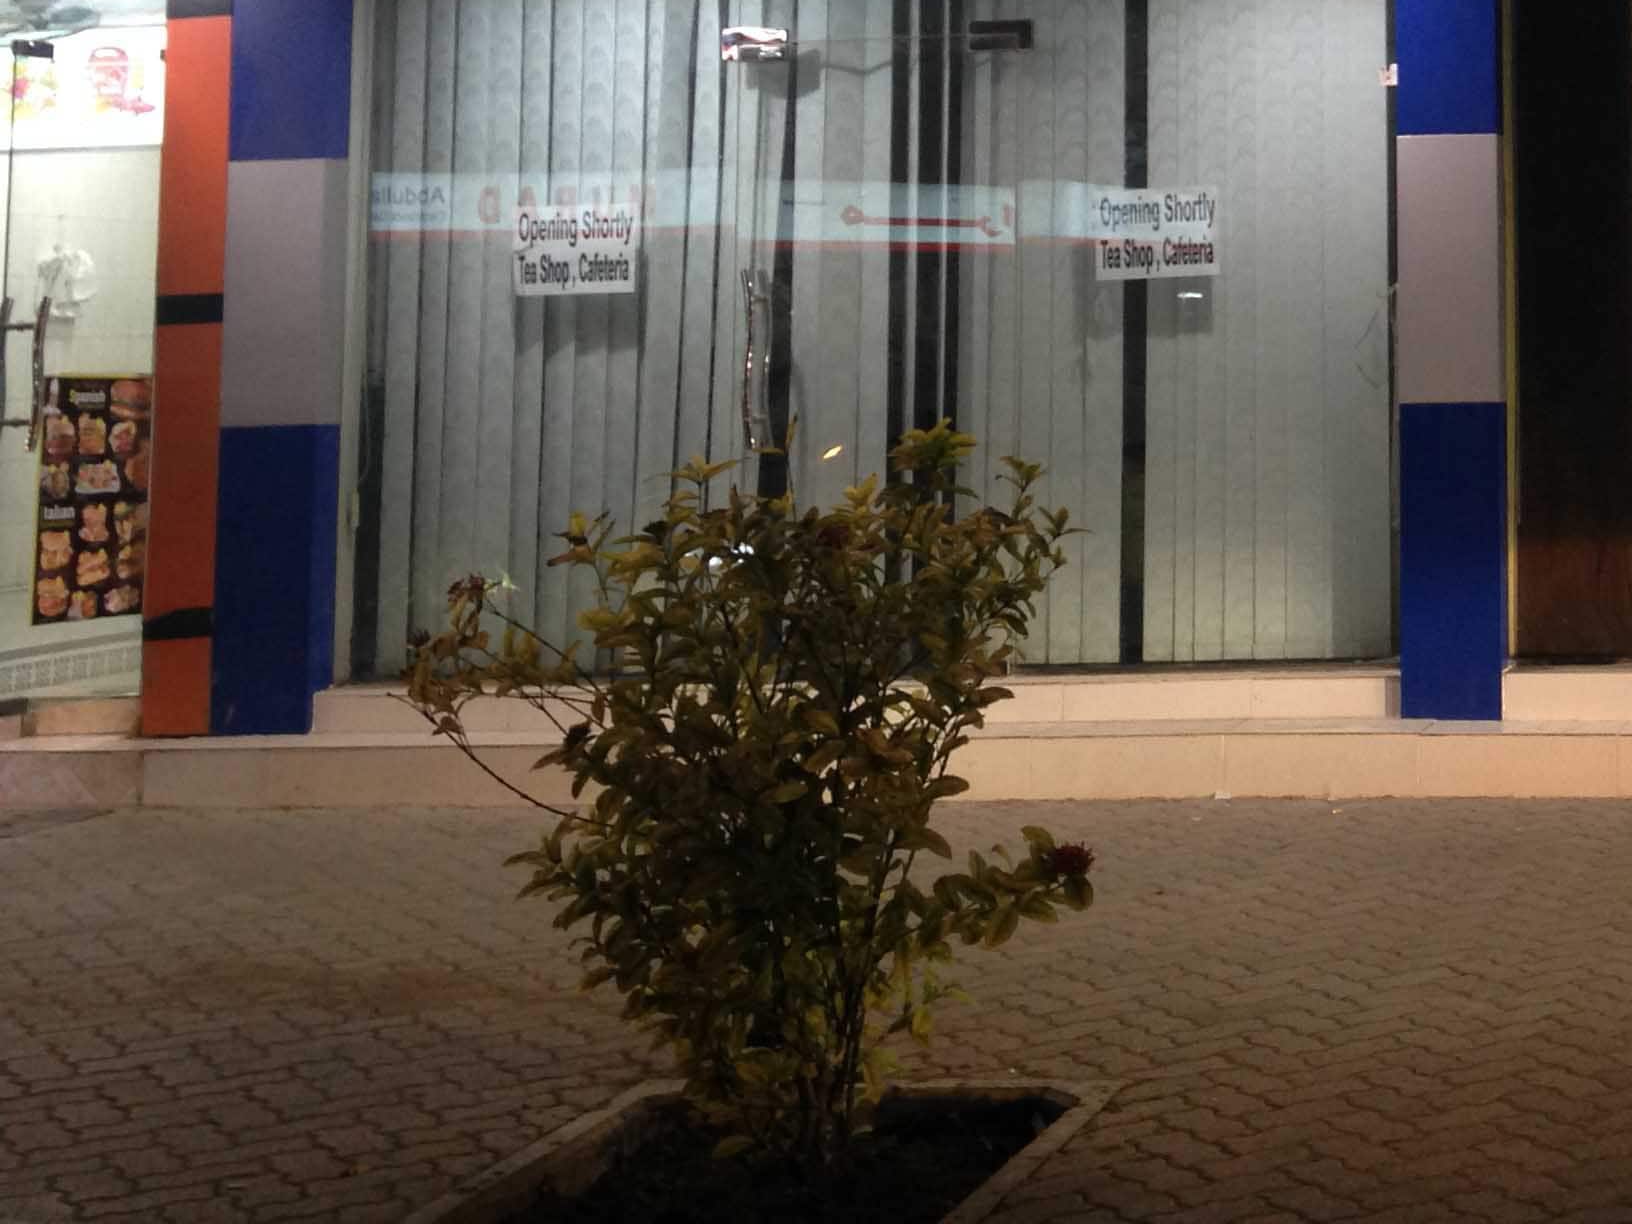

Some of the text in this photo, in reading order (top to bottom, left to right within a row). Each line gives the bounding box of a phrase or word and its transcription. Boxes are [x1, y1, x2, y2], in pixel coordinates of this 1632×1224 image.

[519, 210, 633, 248] Opening Shortly
[1100, 192, 1215, 231] Opening Shortly
[518, 256, 537, 284] Tea
[579, 252, 629, 282] Cafeteria
[1100, 239, 1121, 269] Tea
[1163, 234, 1214, 266] Cafeteria
